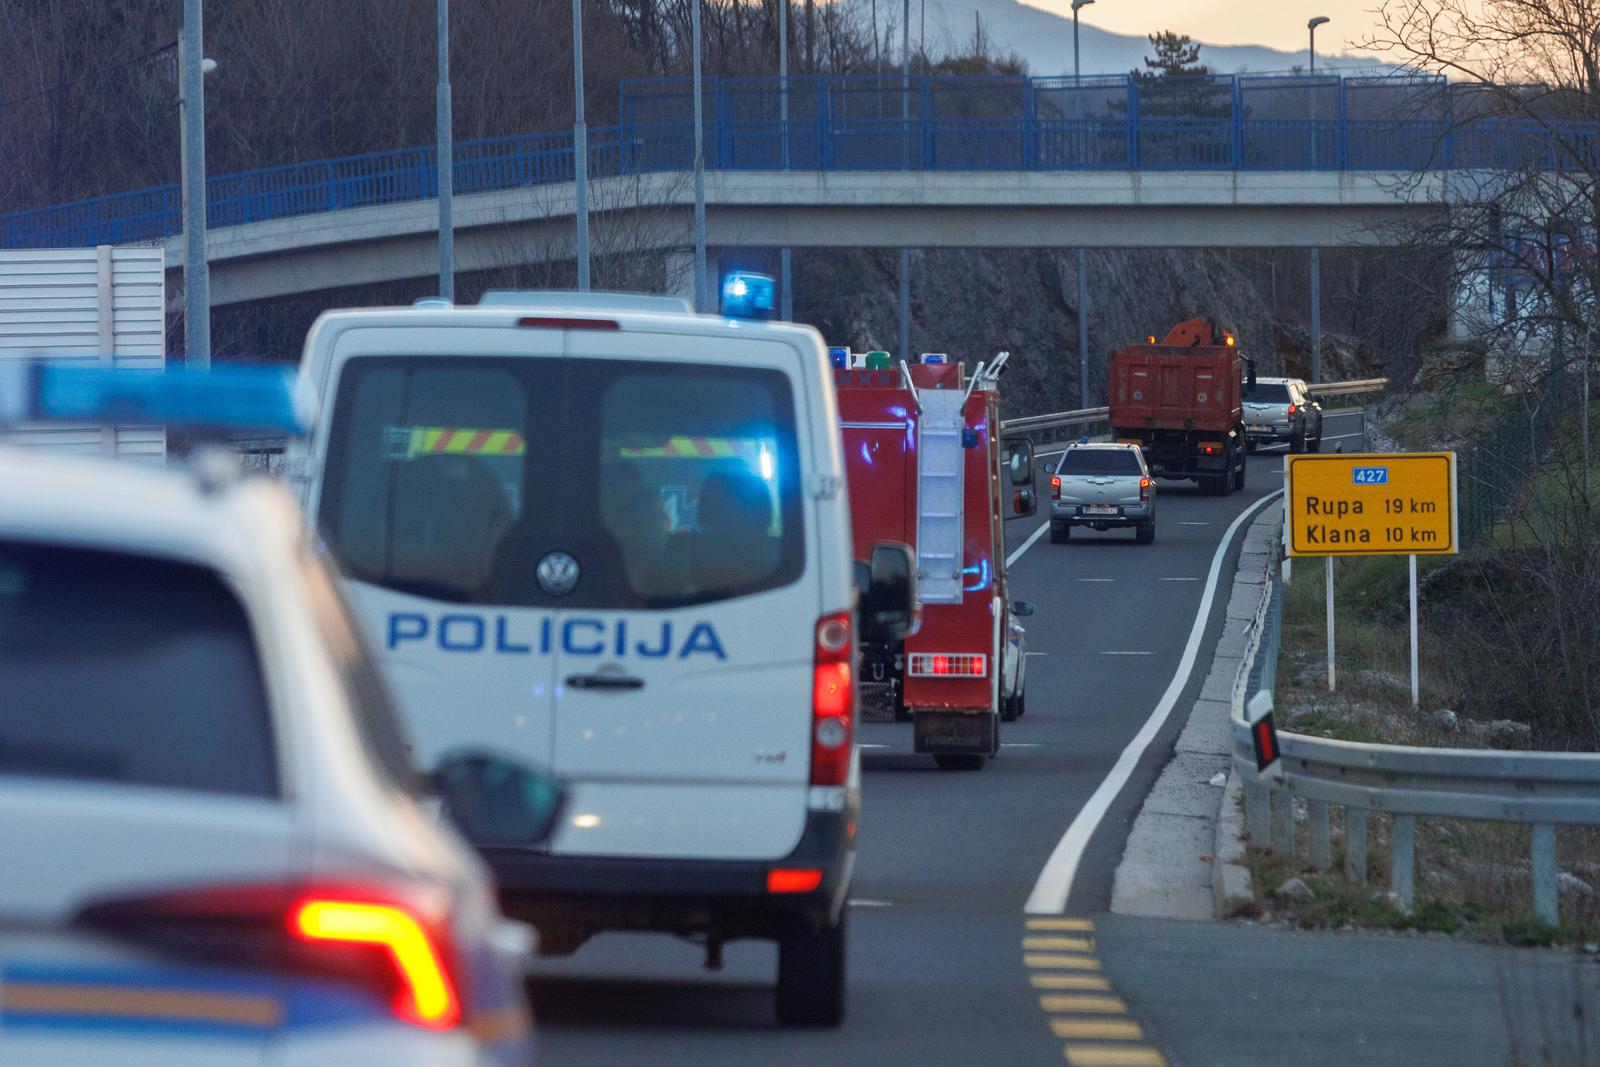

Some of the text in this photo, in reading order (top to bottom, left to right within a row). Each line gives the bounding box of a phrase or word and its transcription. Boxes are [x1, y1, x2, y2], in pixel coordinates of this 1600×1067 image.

[1356, 470, 1384, 482] 427
[1306, 497, 1436, 519] Rupa 19 km
[1307, 525, 1436, 543] Klana 10 km
[537, 552, 579, 593] VW
[387, 612, 727, 661] POLICIJA
